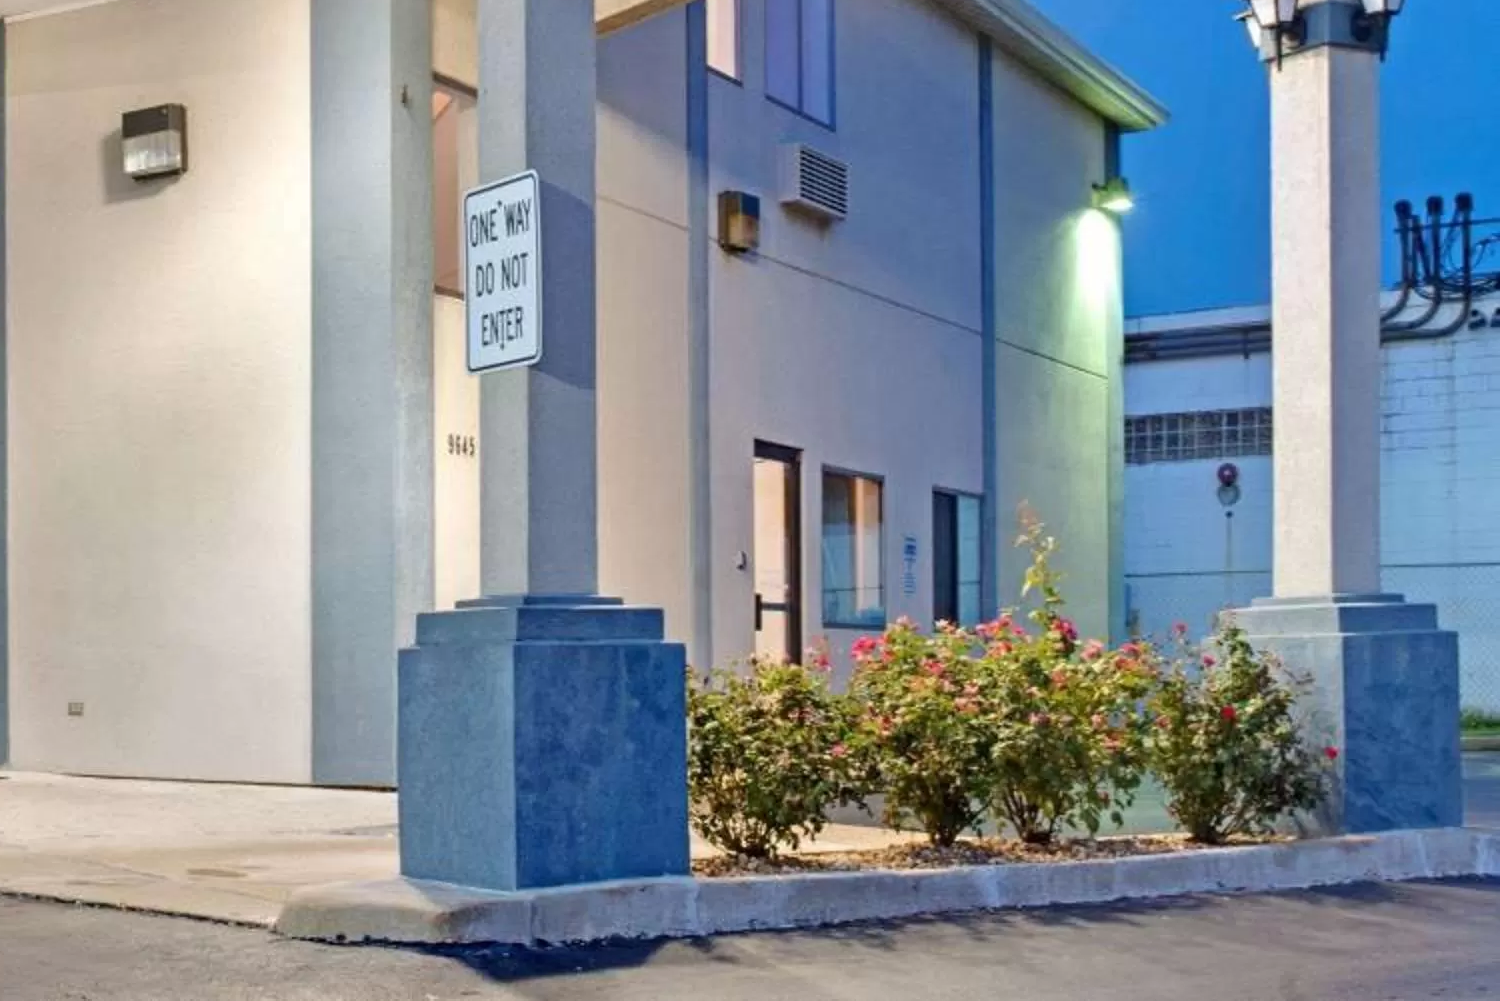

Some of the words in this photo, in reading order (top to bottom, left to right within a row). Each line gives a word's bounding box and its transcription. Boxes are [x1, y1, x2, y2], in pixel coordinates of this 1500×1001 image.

[470, 209, 498, 247] ONE
[504, 198, 531, 237] WAY
[476, 263, 495, 297] DO
[501, 253, 528, 290] NOT
[482, 307, 523, 346] ENTER
